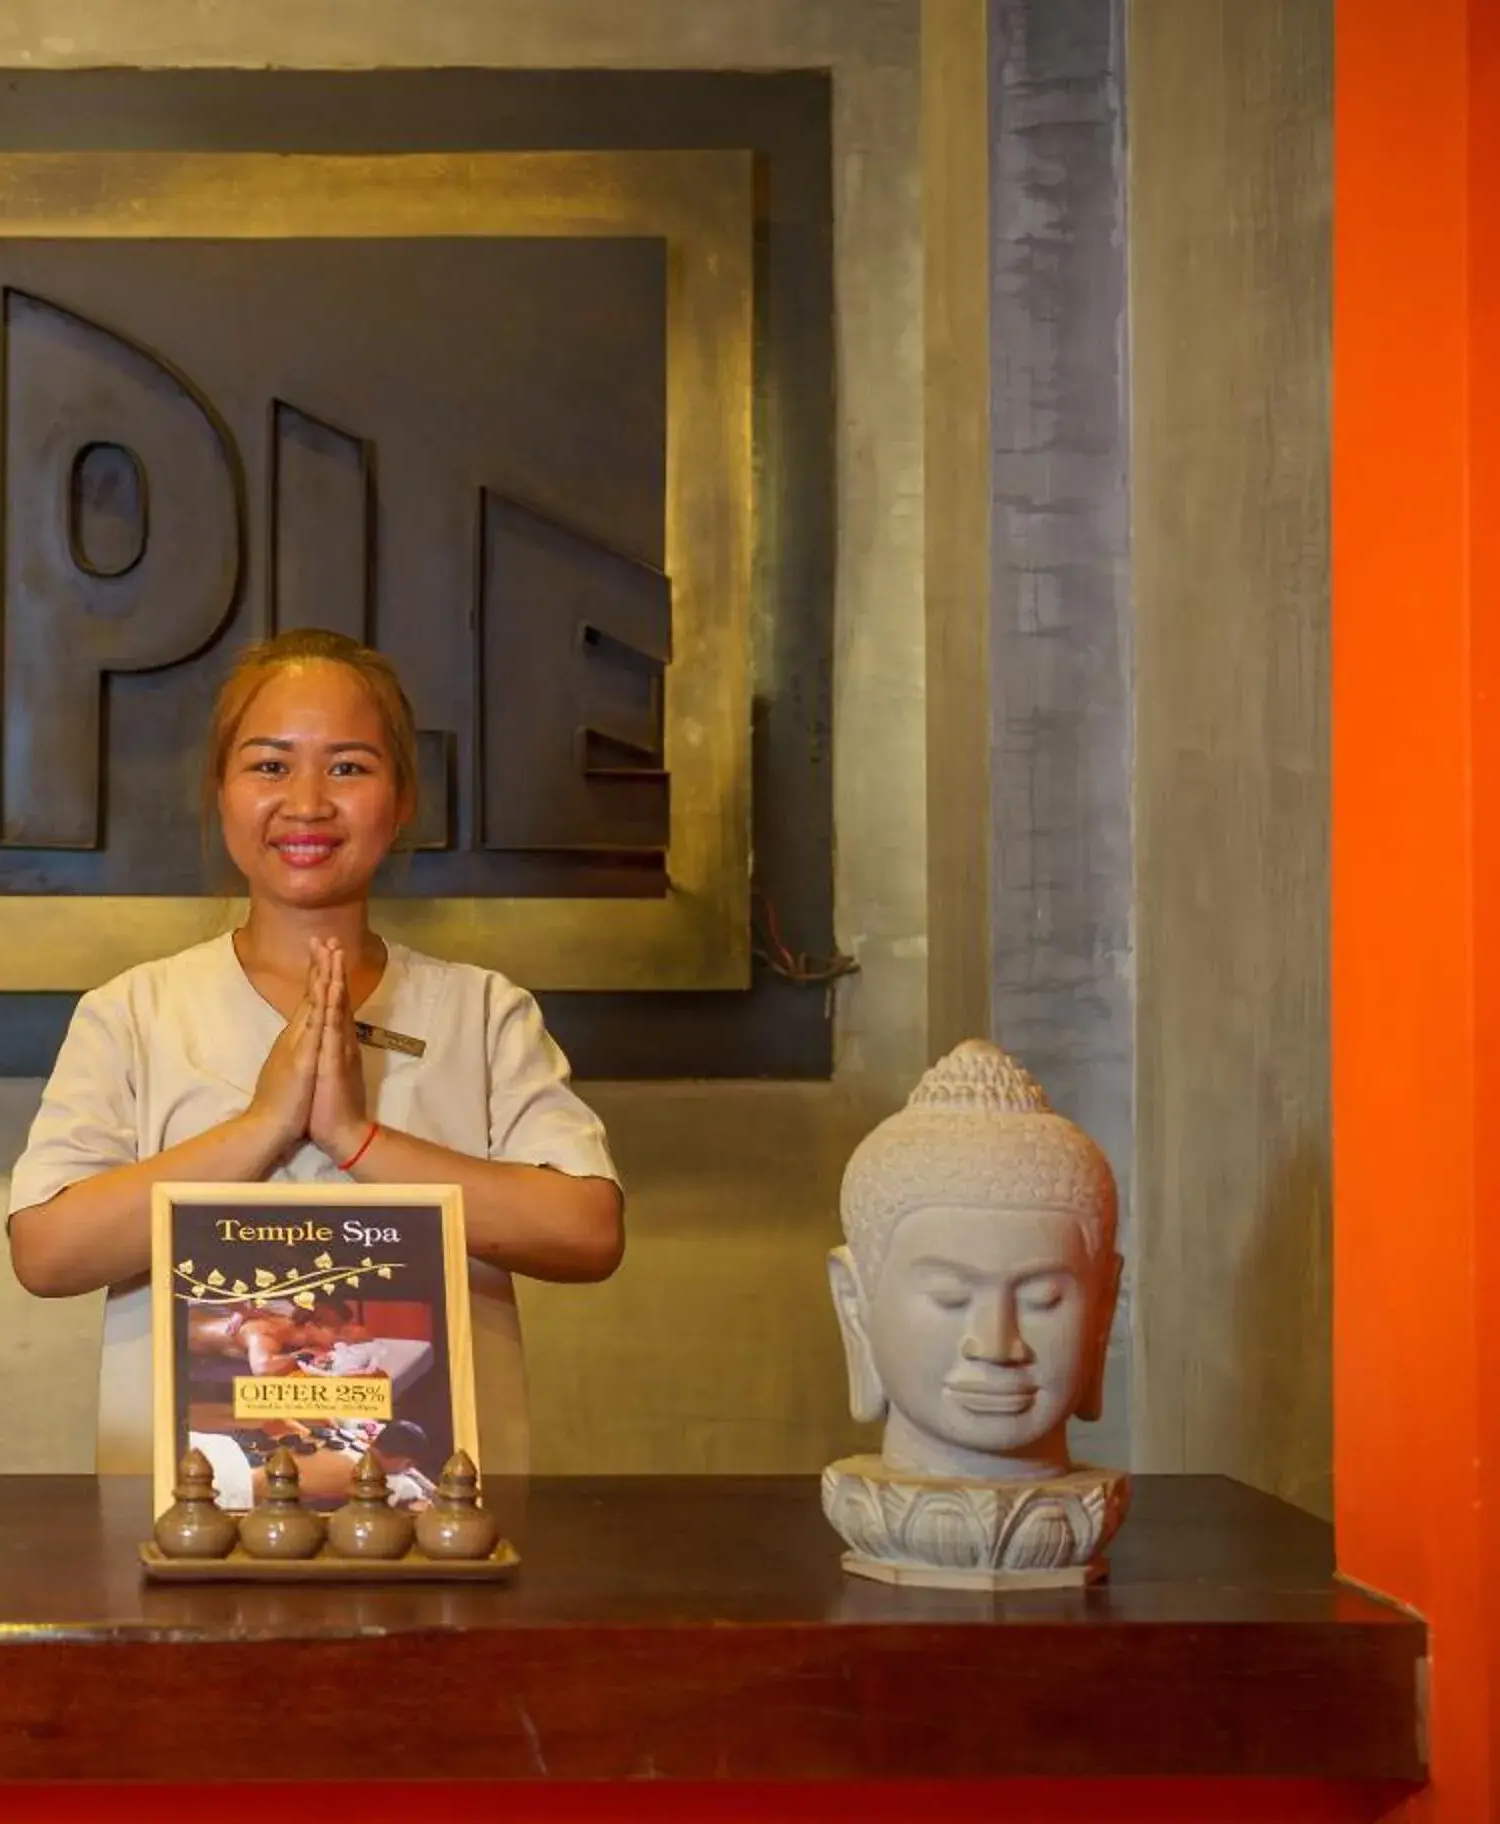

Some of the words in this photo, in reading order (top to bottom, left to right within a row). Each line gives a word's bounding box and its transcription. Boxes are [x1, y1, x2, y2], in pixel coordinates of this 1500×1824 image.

[215, 1218, 334, 1247] Temple
[342, 1219, 401, 1247] Spa
[240, 1383, 329, 1402] OFFER
[335, 1383, 385, 1403] 25%
